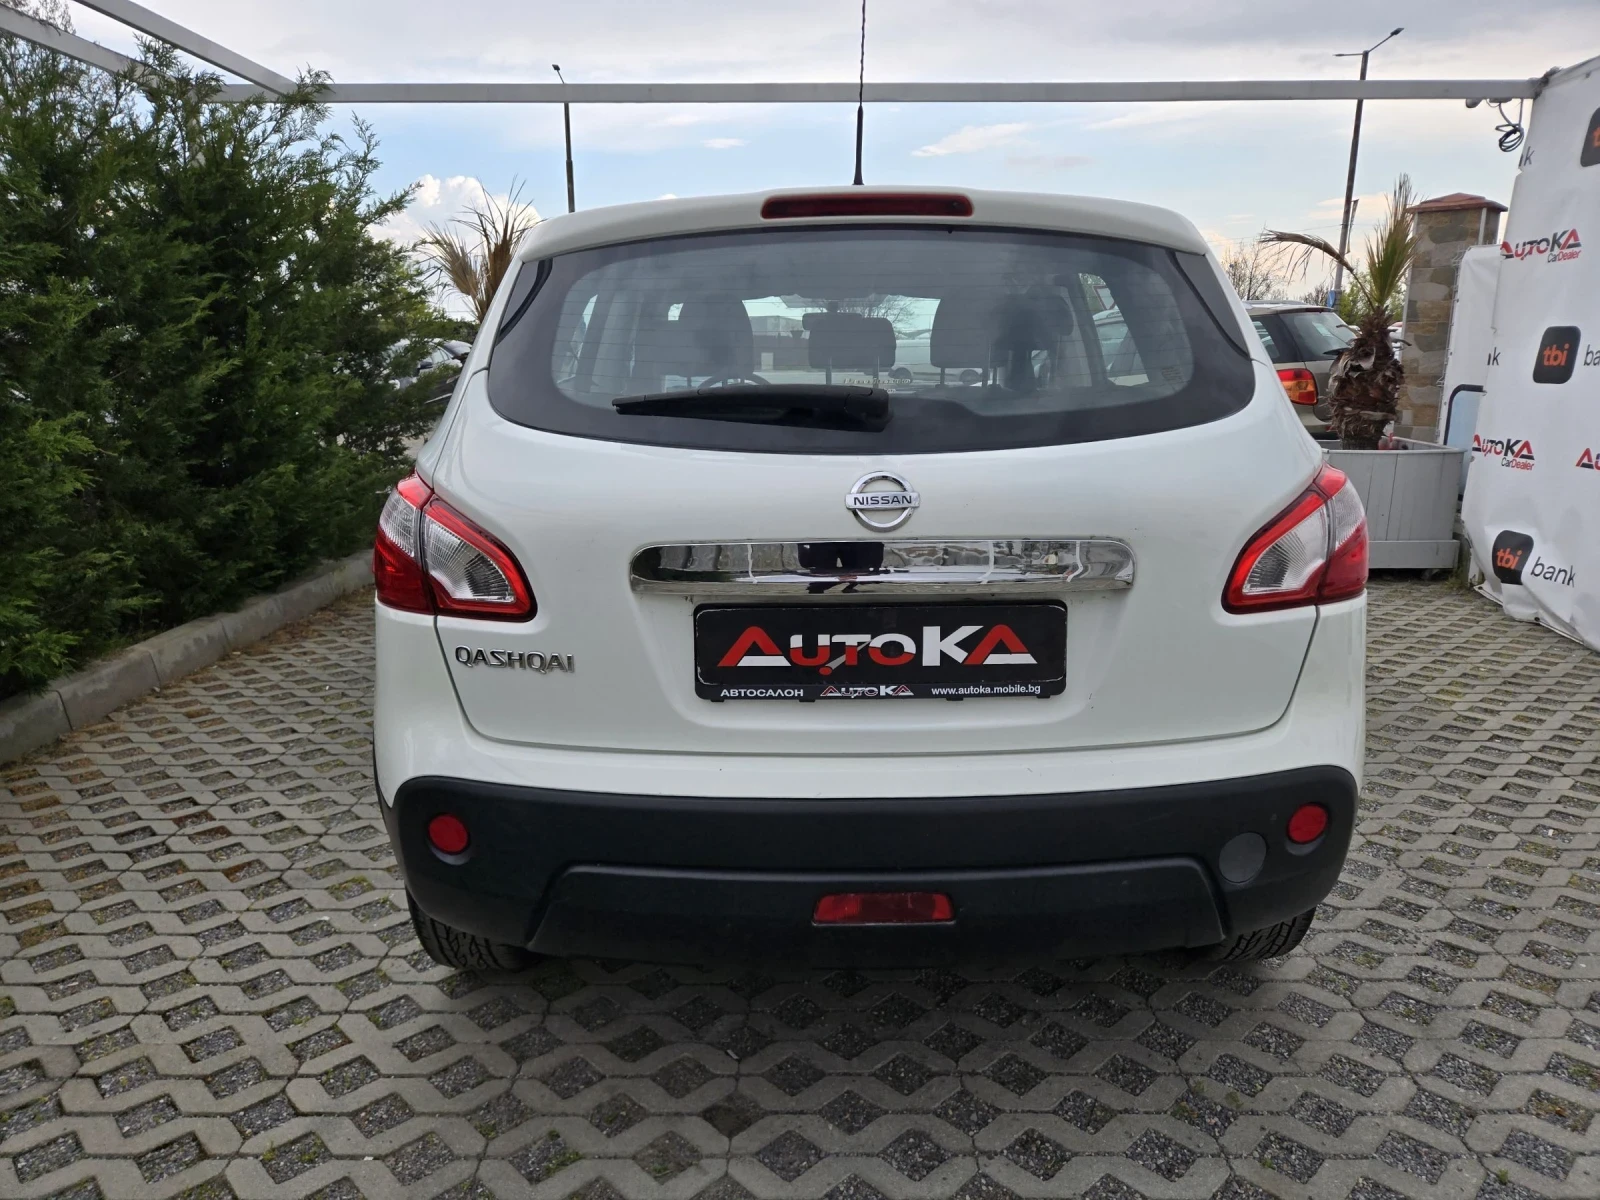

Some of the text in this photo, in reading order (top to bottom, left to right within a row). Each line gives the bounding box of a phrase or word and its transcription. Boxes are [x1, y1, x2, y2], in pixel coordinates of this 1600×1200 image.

[1543, 343, 1570, 367] tbi
[853, 495, 912, 506] NISSAN
[1496, 547, 1576, 588] tbi bank
[455, 645, 575, 675] QASHQAI
[720, 688, 804, 697] АВТОСАЛОН
[931, 684, 1041, 695] www.autoka.mobile.bg
